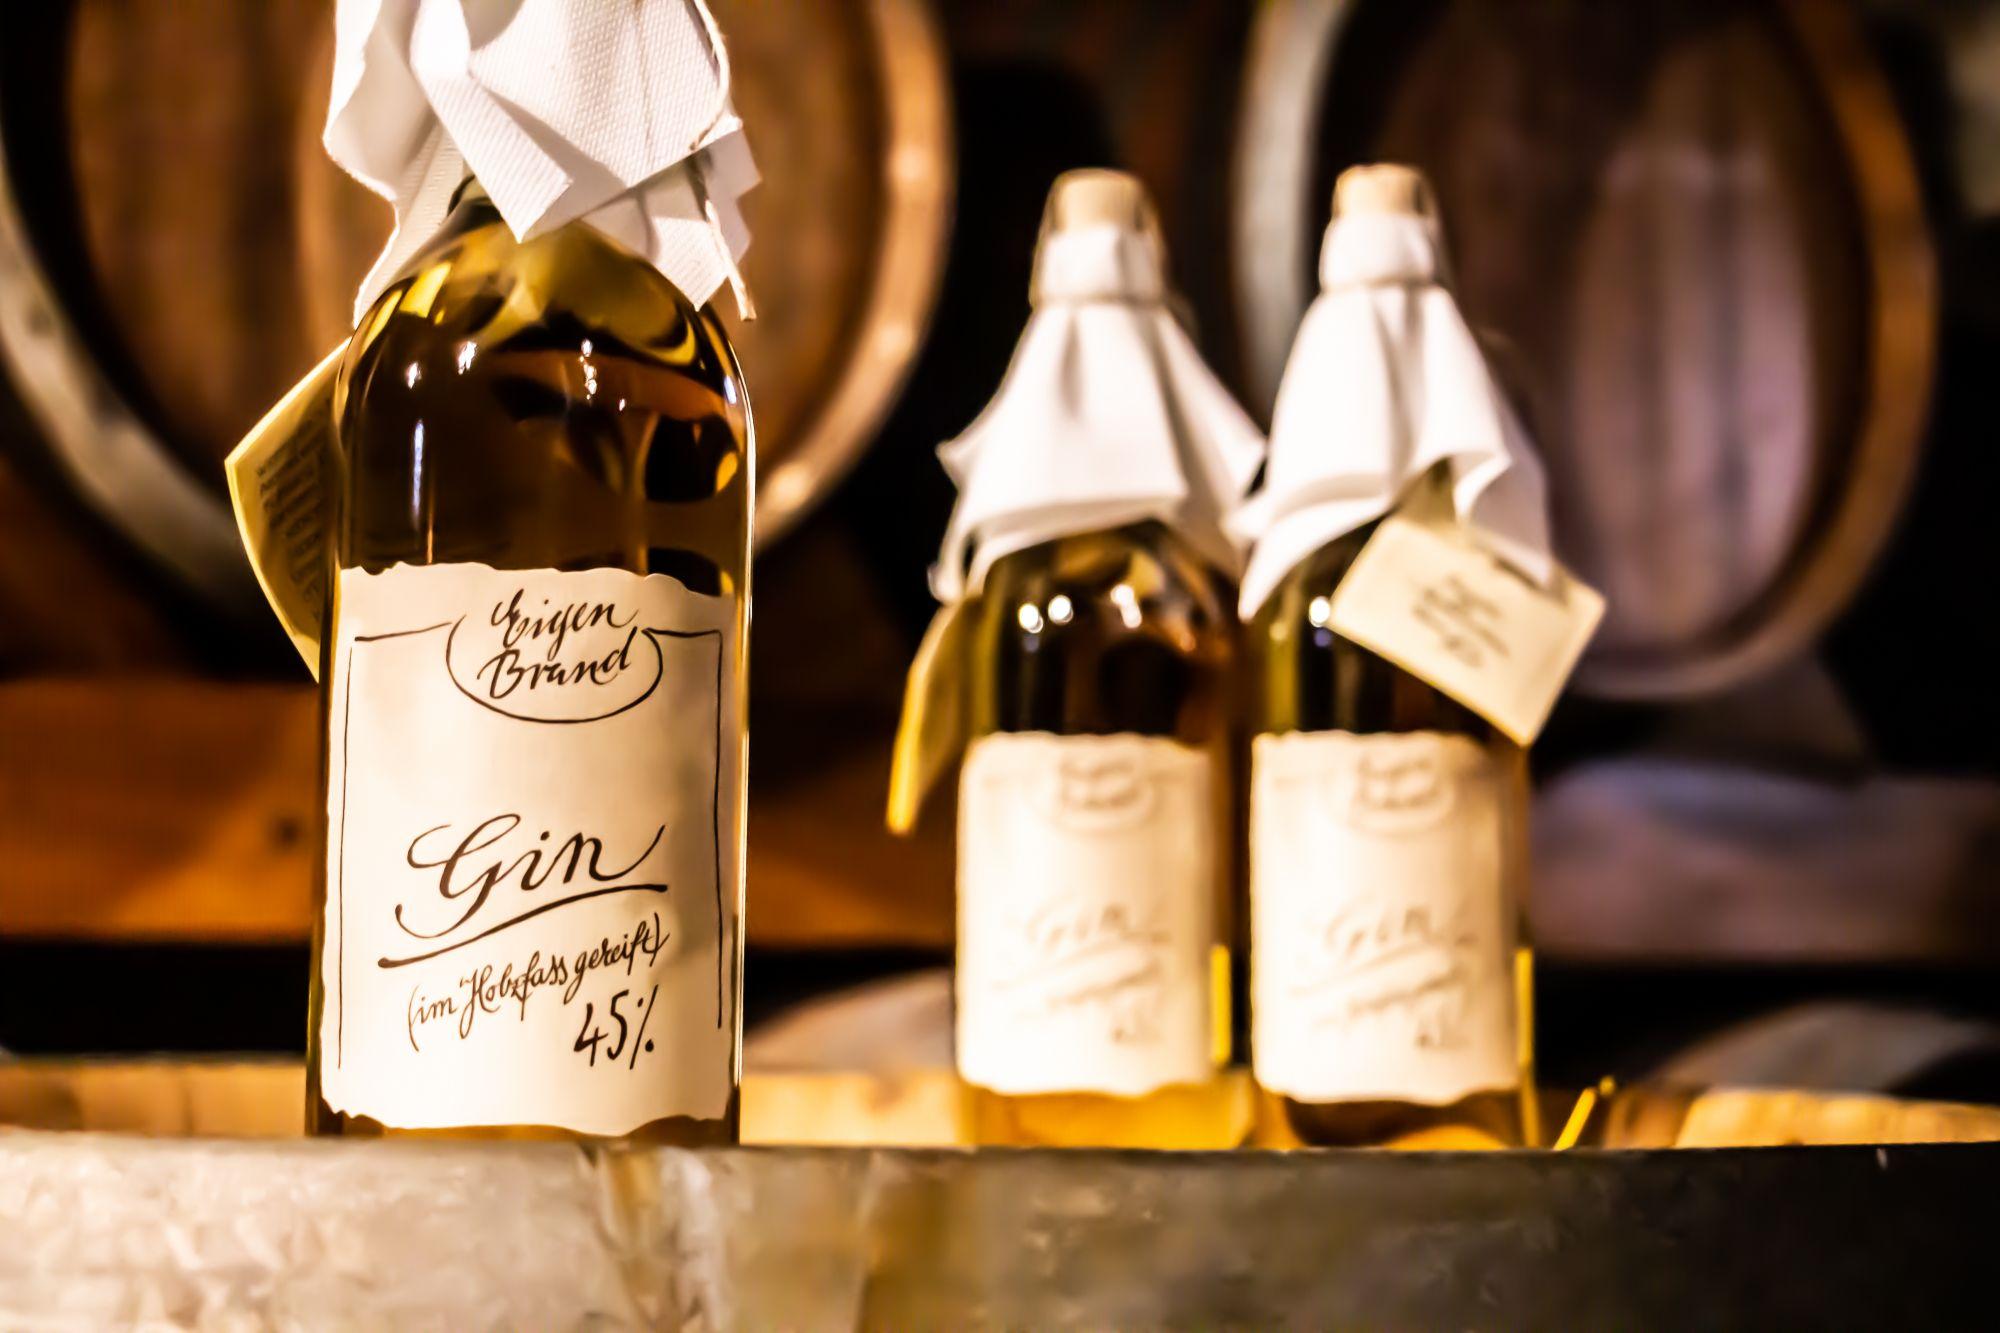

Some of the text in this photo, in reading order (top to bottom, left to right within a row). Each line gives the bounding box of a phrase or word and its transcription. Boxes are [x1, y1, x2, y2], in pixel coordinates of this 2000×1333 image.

[476, 626, 638, 699] Brand
[491, 588, 640, 661] Eigen
[395, 813, 666, 938] Gin
[563, 912, 670, 1005] gereift)
[573, 983, 659, 1069] 45%
